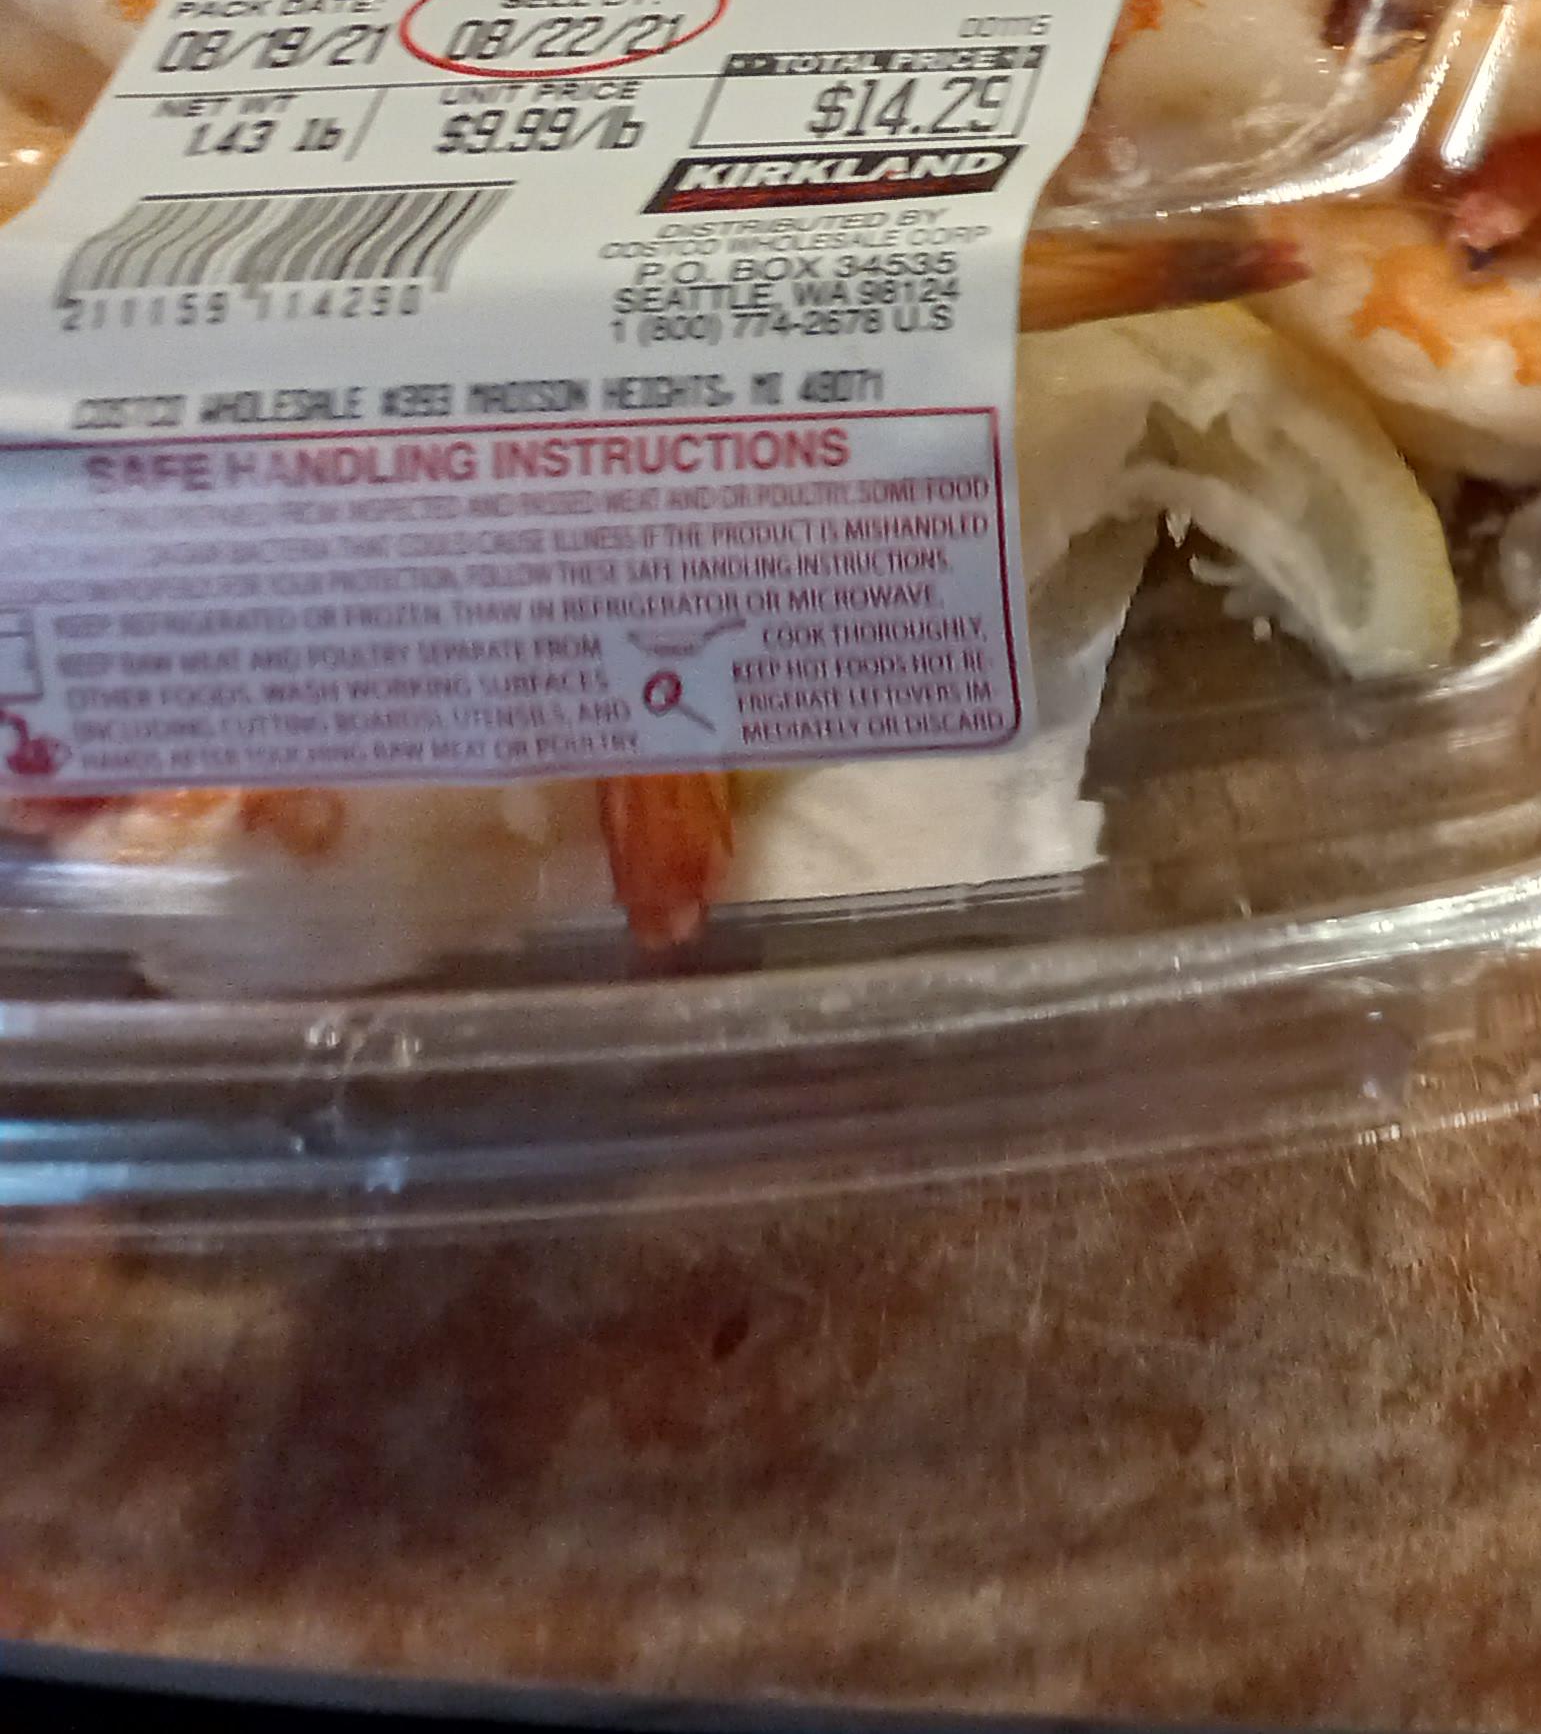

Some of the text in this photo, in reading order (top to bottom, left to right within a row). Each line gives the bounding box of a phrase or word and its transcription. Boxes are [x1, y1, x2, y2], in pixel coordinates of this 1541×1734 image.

[170, 0, 271, 18] PACK
[445, 14, 686, 60] 08/22/21
[773, 51, 998, 75] TOTAL PRICE
[151, 94, 298, 118] NET WT
[439, 80, 643, 105] UNIT PRICE
[808, 76, 1011, 137] $14.29
[291, 118, 343, 152] lb
[436, 105, 646, 154] $9.99/lb
[674, 152, 1007, 192] KIRKLAND
[656, 208, 948, 239] DISTRIBUTED BY
[600, 239, 719, 259] COSTCO
[731, 256, 821, 282] BOX
[834, 251, 957, 278] 34535
[792, 279, 849, 305] WA
[611, 319, 626, 344] 1
[85, 427, 852, 493] SAFE HANDLING INSTRUCTIONS
[926, 475, 990, 502] FOOD
[845, 513, 989, 541] MISHANDLED
[562, 591, 740, 621] REFRIGERATOR
[762, 626, 824, 648] COOK
